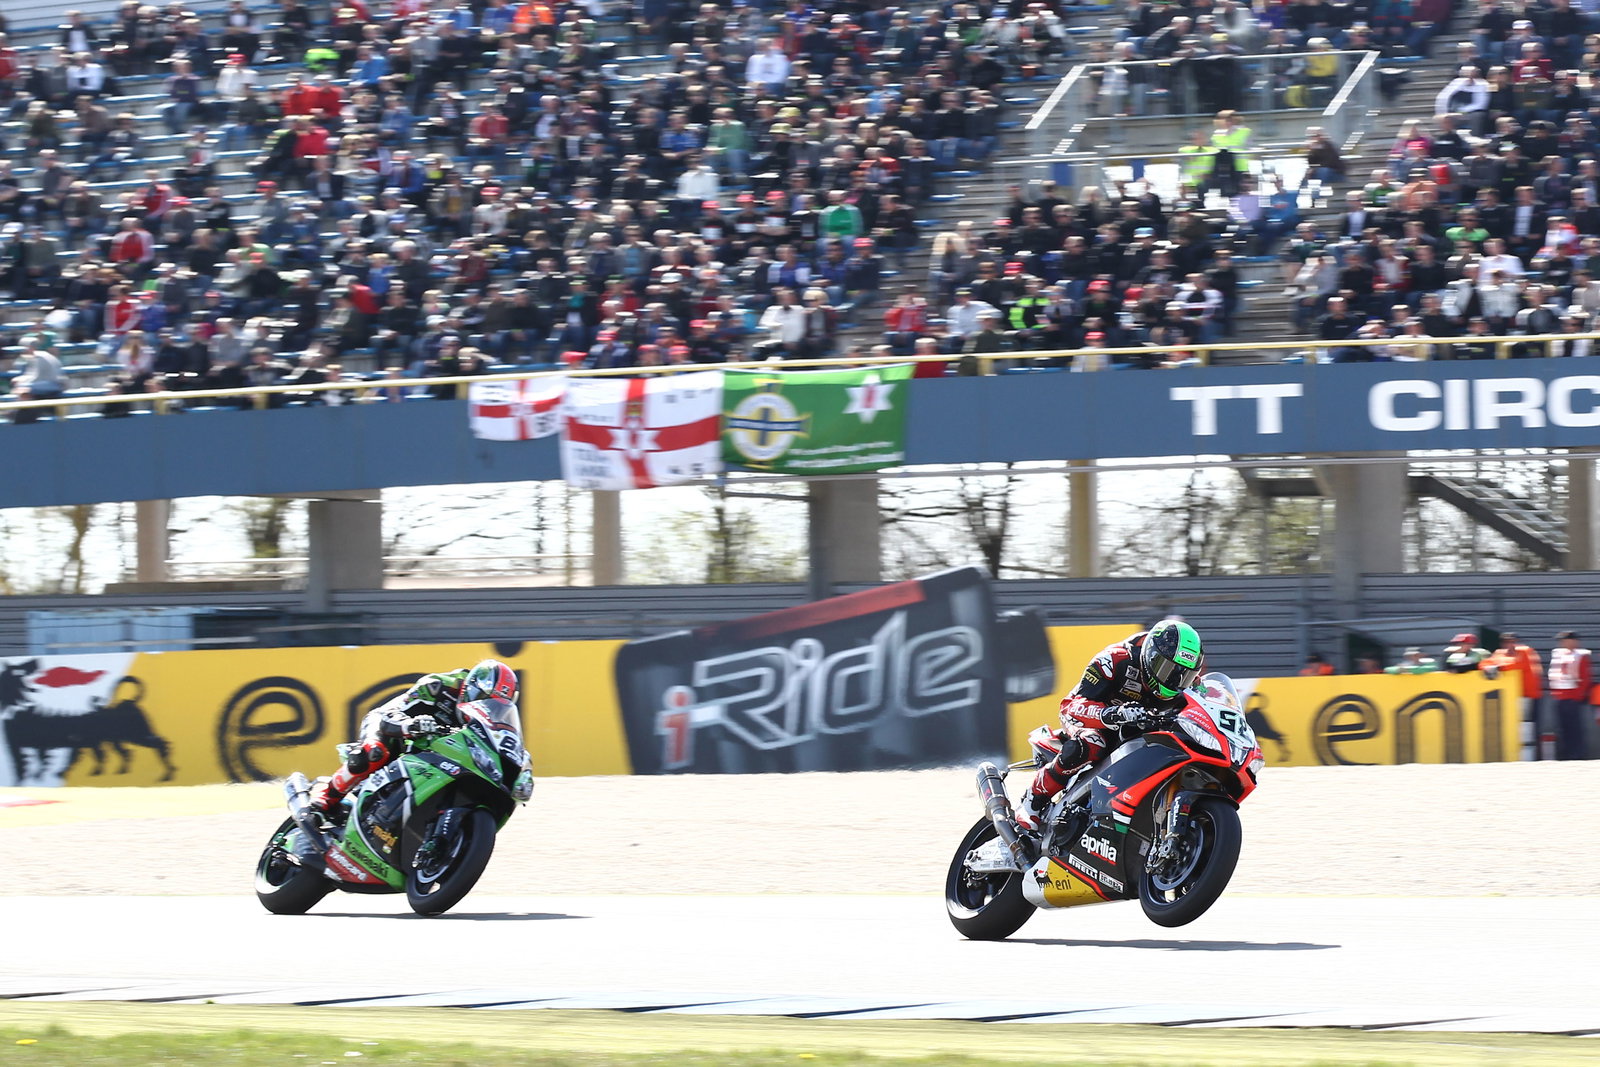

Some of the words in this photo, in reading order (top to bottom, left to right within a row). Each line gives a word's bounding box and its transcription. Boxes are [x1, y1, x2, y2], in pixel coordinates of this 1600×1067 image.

[1169, 383, 1303, 435] TT
[1368, 375, 1600, 431] CIRC
[1313, 689, 1504, 765] eni
[346, 840, 388, 878] Kawasaki
[1081, 833, 1117, 862] aprilia
[1055, 875, 1072, 890] eni
[1069, 853, 1099, 880] PIRELLI
